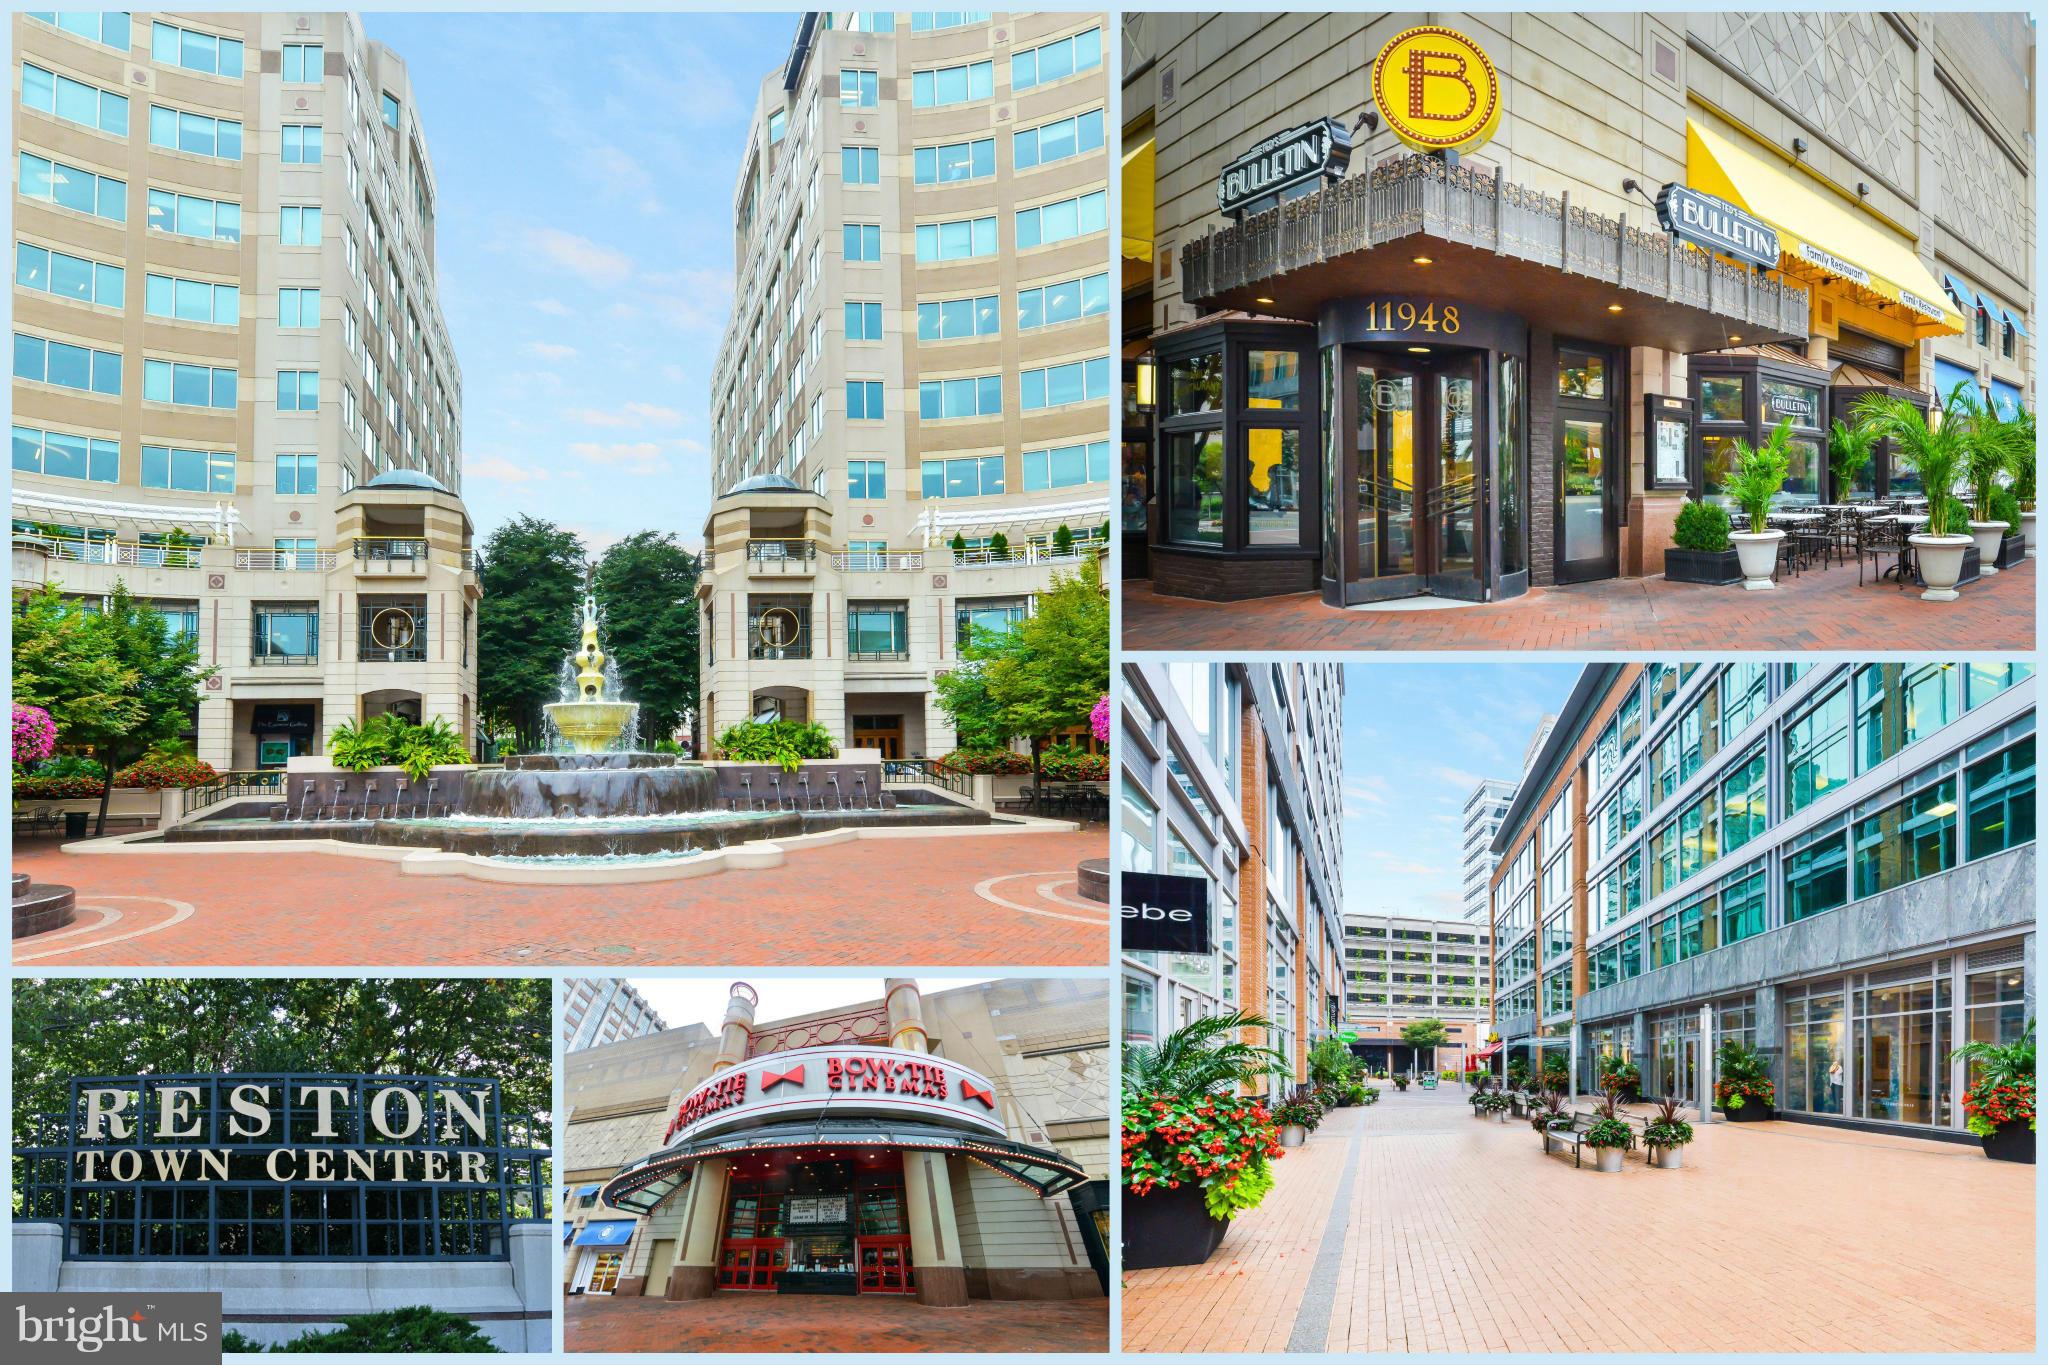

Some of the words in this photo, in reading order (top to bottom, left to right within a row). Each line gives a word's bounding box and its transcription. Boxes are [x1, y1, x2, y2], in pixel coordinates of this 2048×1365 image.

[1402, 49, 1477, 122] B
[1226, 134, 1319, 201] BULLETIN
[1682, 198, 1772, 257] BULLETIN
[1806, 245, 1829, 267] Family
[1830, 256, 1865, 281] Restaurant
[1365, 301, 1460, 334] 11948
[1775, 398, 1808, 413] BULLETIN
[1121, 903, 1193, 922] ebe
[828, 1074, 949, 1100] CINEMAS
[80, 1084, 490, 1141] RESTON
[676, 1089, 745, 1131] CINEMAS
[76, 1149, 233, 1182] TOWN
[266, 1148, 490, 1184] CENTER
